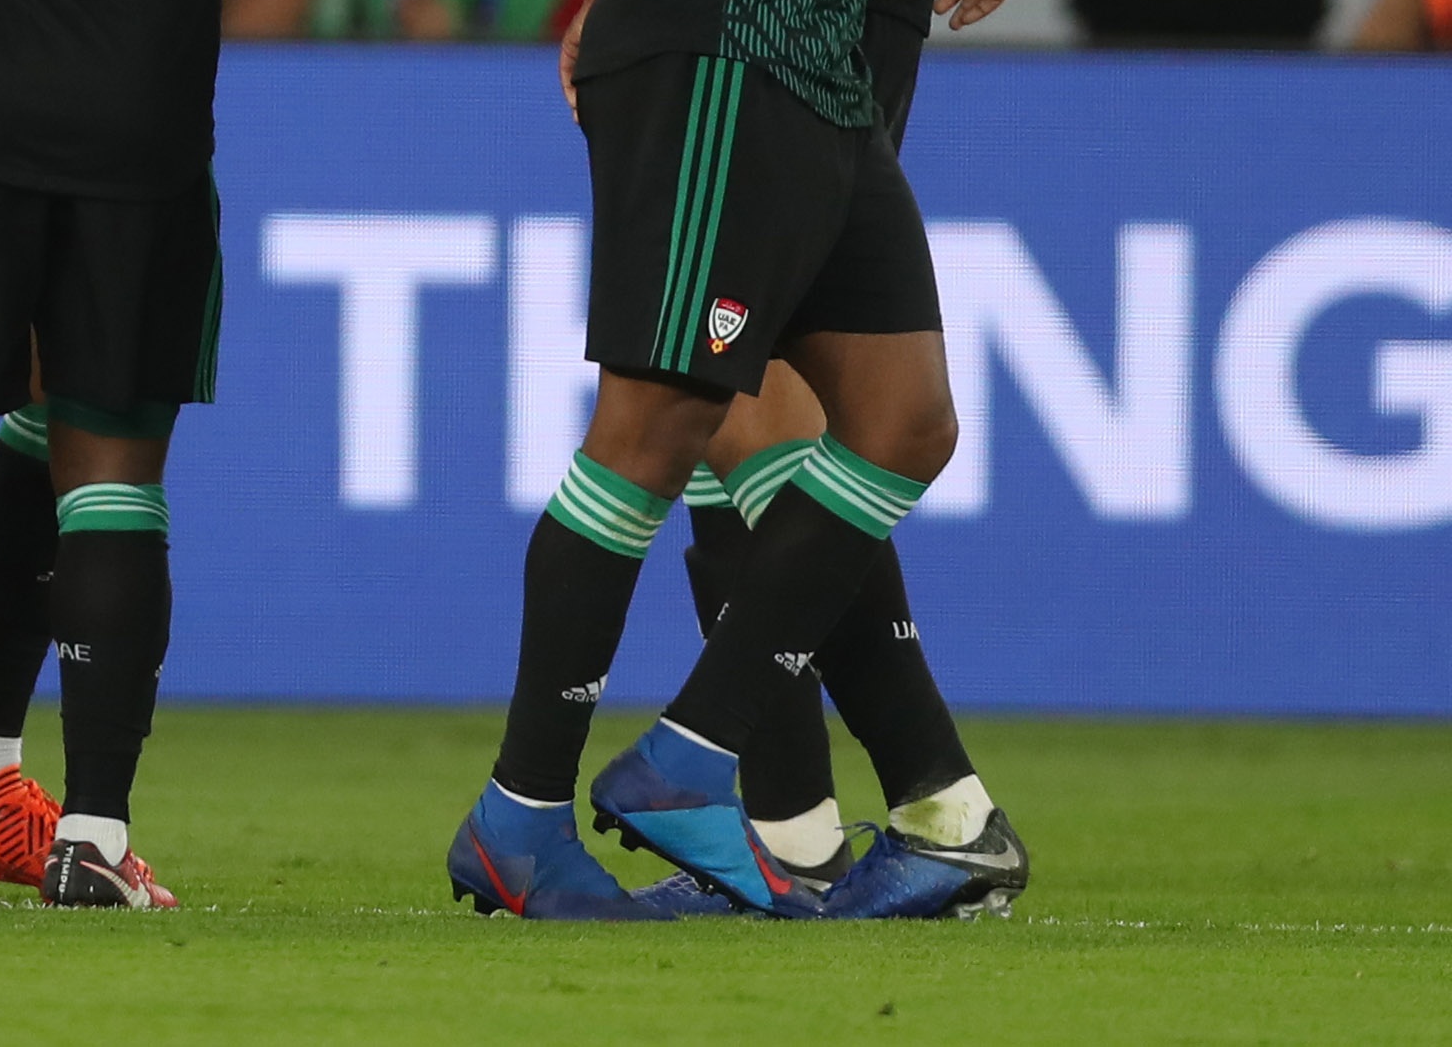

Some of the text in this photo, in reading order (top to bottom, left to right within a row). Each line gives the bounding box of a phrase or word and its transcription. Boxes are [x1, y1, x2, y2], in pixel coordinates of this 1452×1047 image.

[892, 621, 920, 640] UA
[57, 642, 92, 662] AE
[561, 690, 600, 703] adid
[58, 845, 74, 893] TIEMPO
